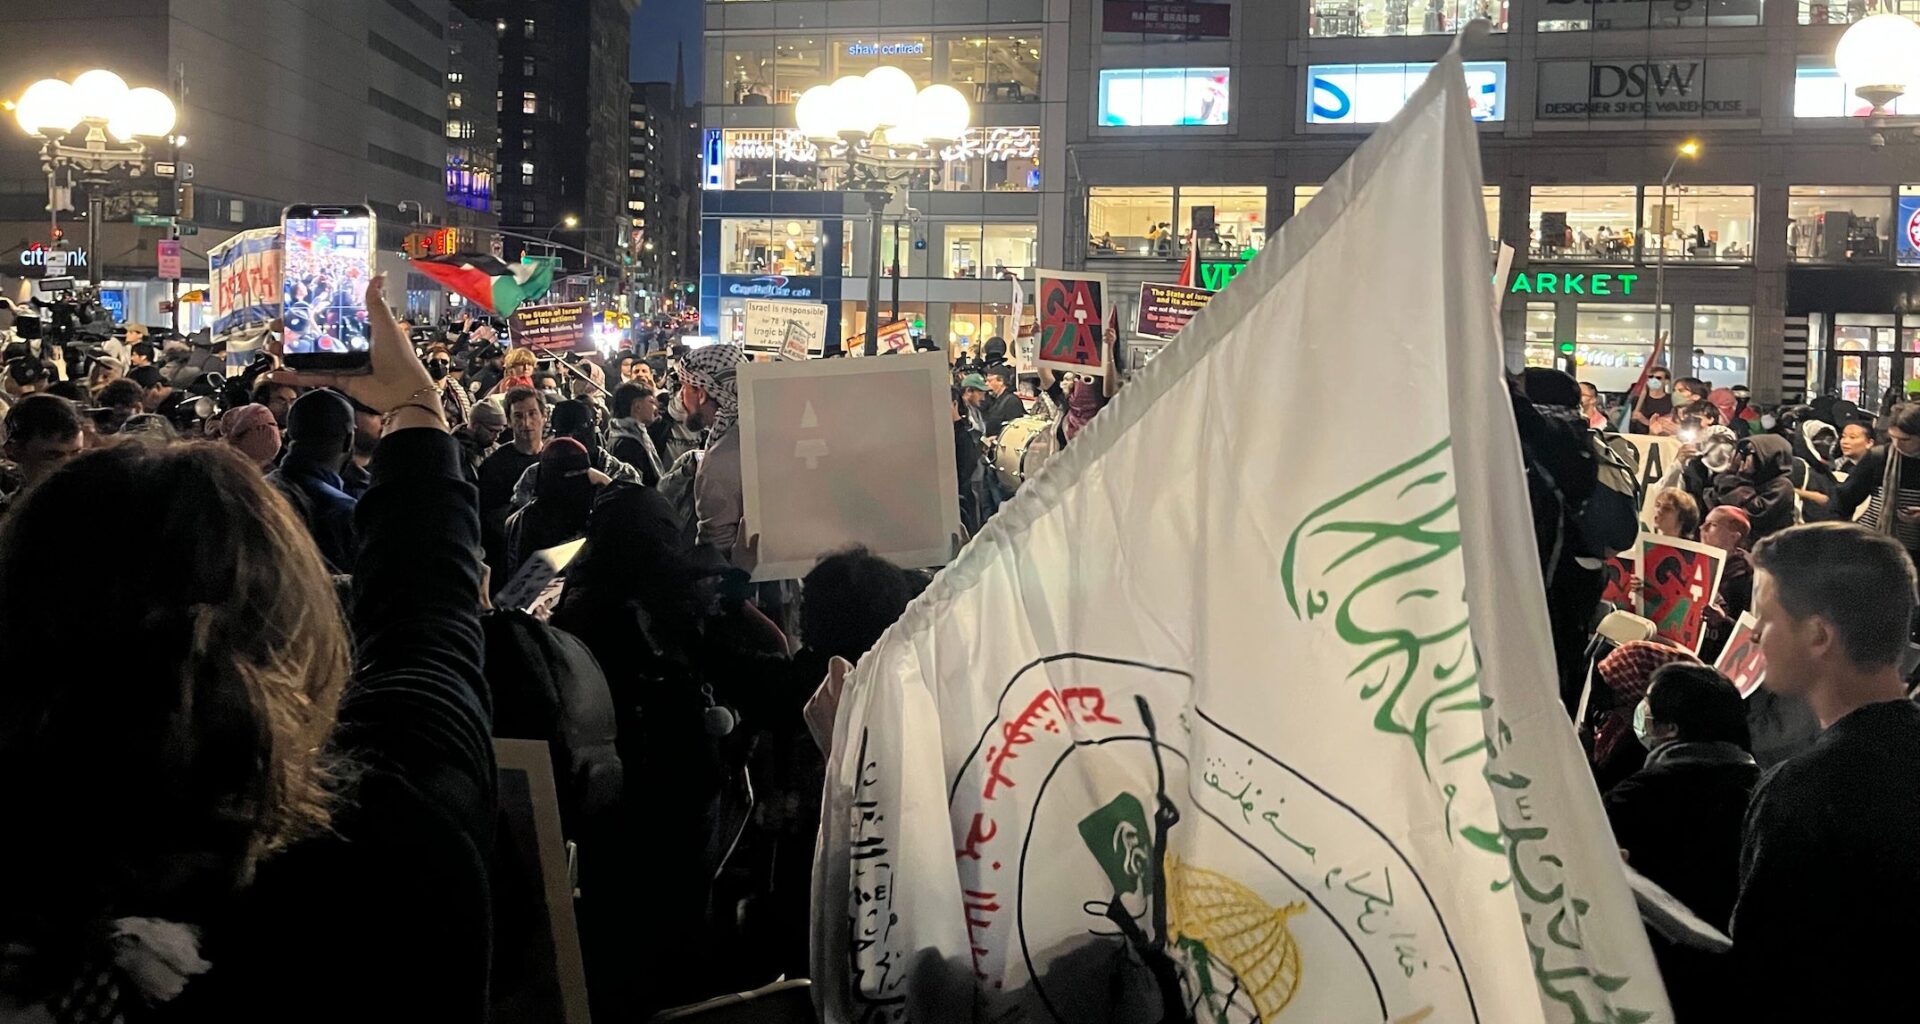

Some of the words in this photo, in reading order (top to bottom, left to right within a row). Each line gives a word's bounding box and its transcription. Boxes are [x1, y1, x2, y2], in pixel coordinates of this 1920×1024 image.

[1131, 12, 1159, 21] NAME
[1163, 13, 1201, 23] BRANDS
[848, 44, 877, 55] shaw
[881, 44, 923, 55] contract
[1590, 62, 1699, 98] DSW
[1544, 102, 1610, 114] DESIGNER
[1614, 101, 1651, 113] SHOE
[1655, 100, 1742, 113] WAREHOUSE
[20, 247, 87, 266] citink
[1509, 272, 1638, 296] ARKET
[1151, 288, 1164, 296] The
[1165, 290, 1185, 298] State
[1156, 296, 1169, 304] and
[1171, 297, 1180, 305] its
[533, 310, 553, 318] State
[562, 306, 583, 315] Israel
[749, 304, 771, 312] Israel
[781, 306, 824, 316] responsible
[1168, 306, 1178, 314] the
[525, 318, 539, 326] and
[540, 317, 550, 325] its
[551, 315, 577, 324] actions
[754, 328, 776, 338] tragic
